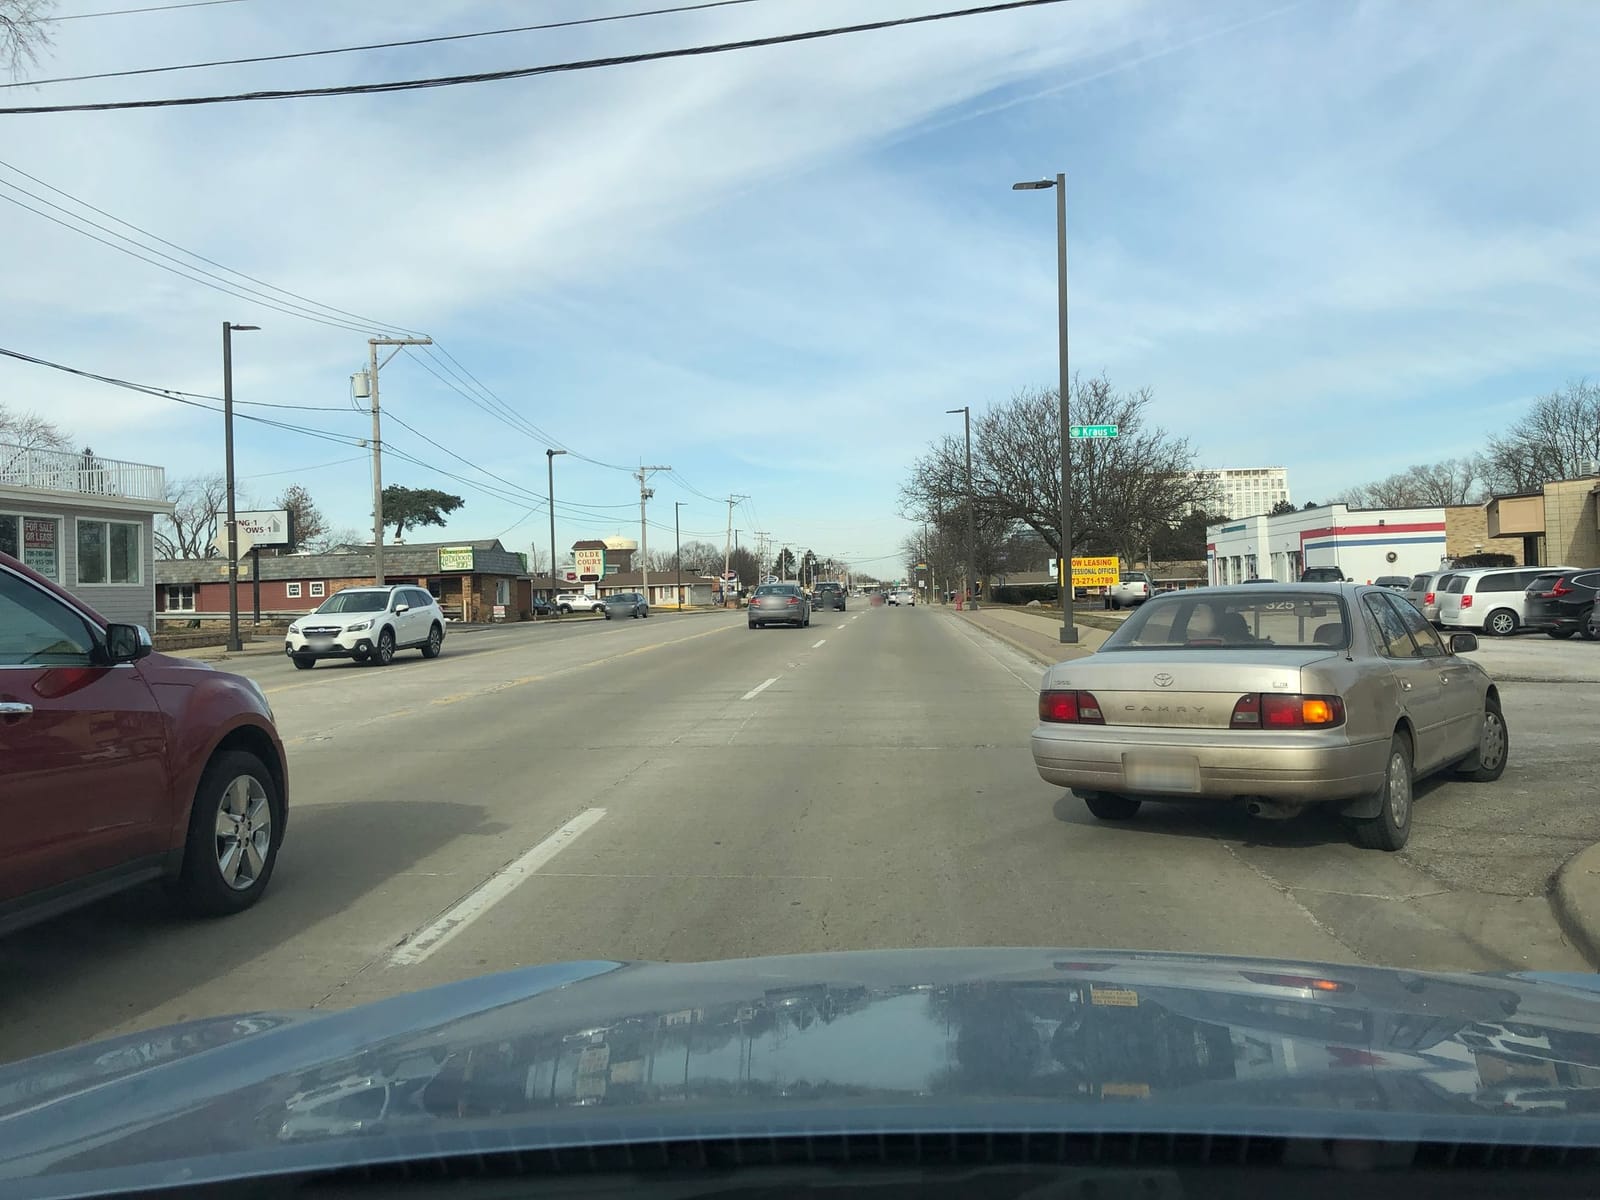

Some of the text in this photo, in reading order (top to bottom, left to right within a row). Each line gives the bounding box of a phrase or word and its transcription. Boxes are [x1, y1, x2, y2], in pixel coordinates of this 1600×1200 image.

[1082, 428, 1108, 437] Kraus
[25, 522, 54, 533] FOR SALE
[25, 532, 54, 543] OR LEASE
[1071, 559, 1112, 567] OW LEASING
[1098, 567, 1118, 575] OFFICES
[1071, 577, 1114, 585] 73-271-1789
[1124, 704, 1205, 713] CAMRY
